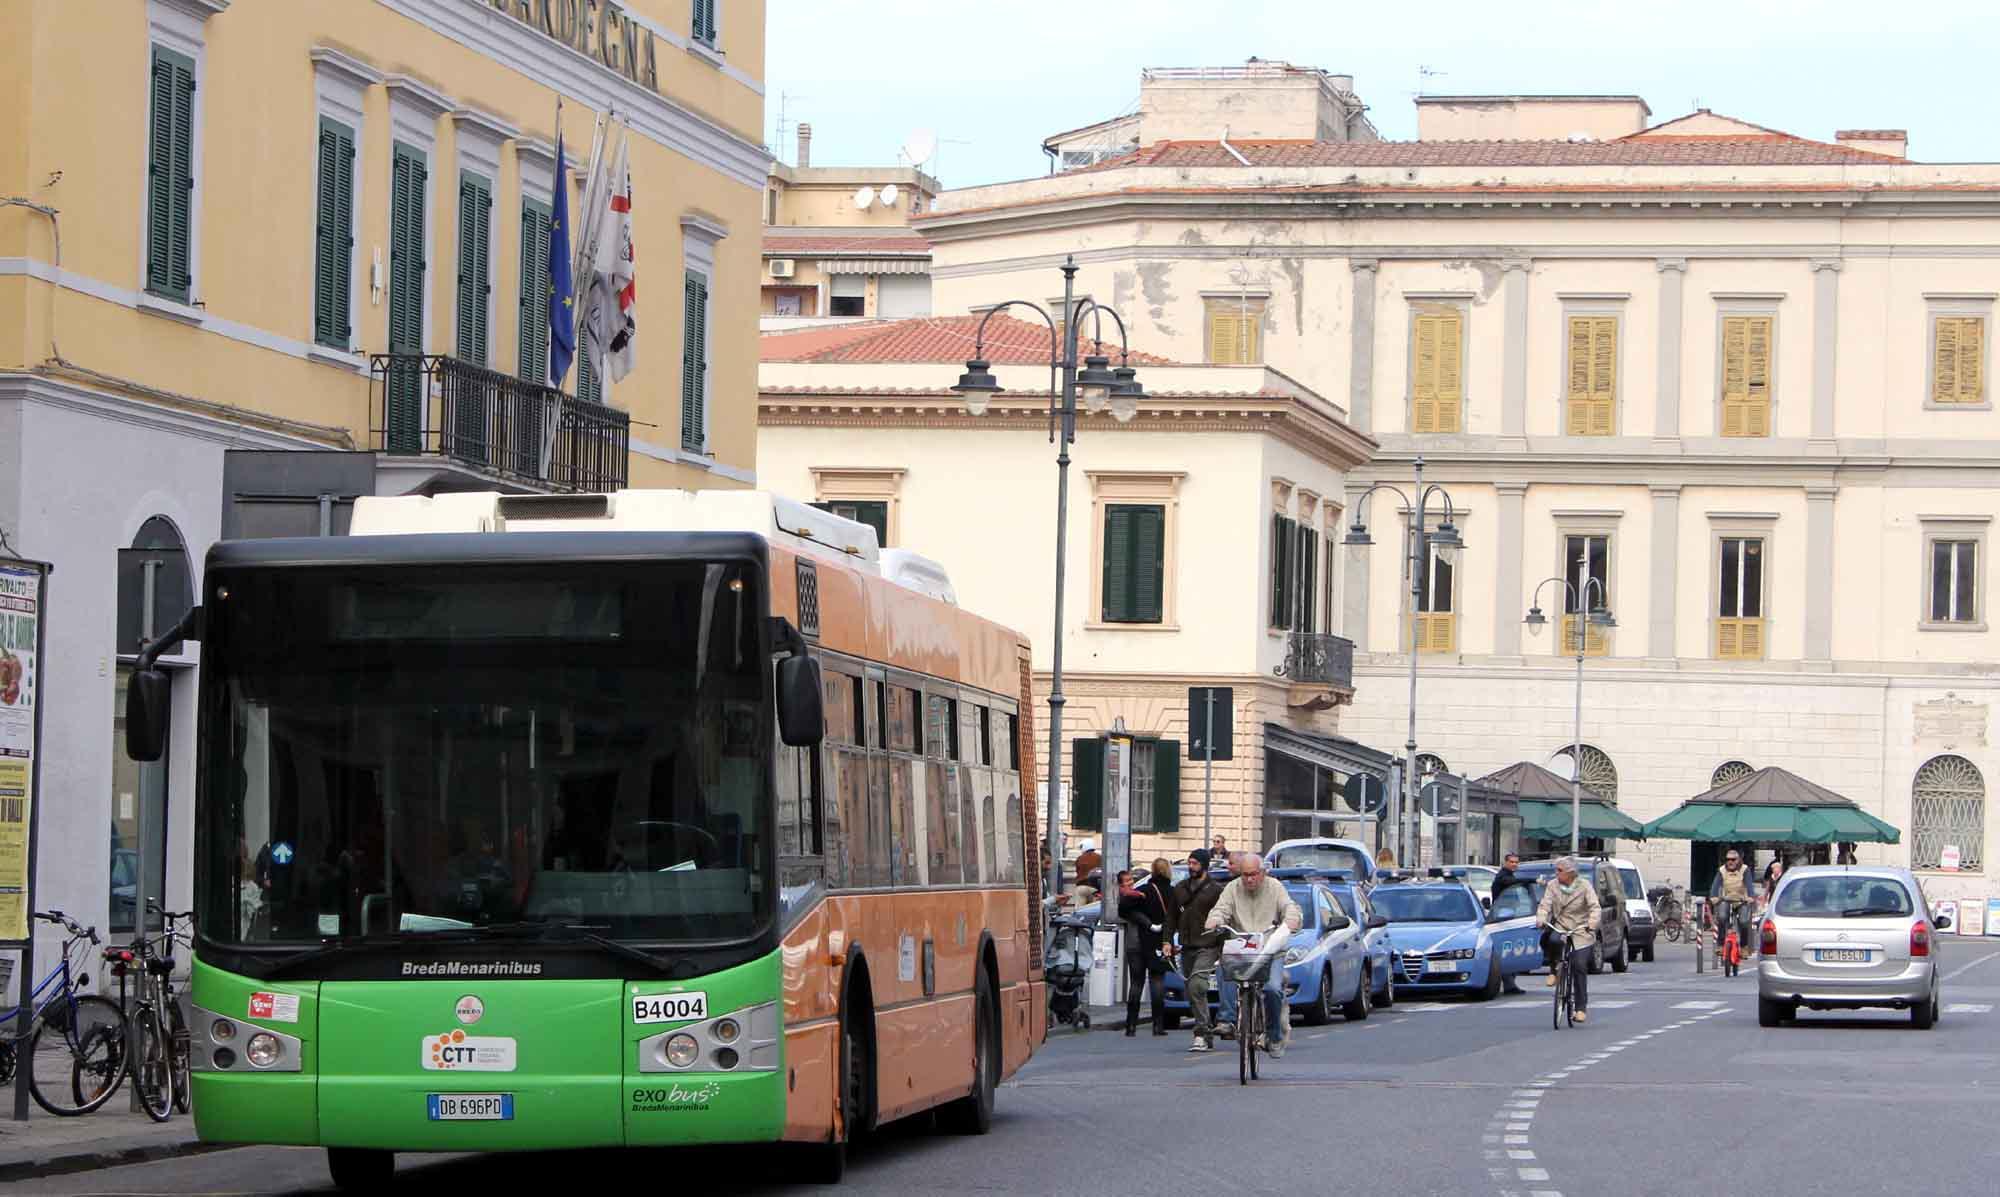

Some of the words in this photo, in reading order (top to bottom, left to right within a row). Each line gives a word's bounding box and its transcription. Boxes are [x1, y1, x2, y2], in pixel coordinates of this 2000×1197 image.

[402, 961, 541, 975] BredaMenarinibus
[635, 998, 703, 1019] B4004
[442, 1047, 476, 1063] CTT
[632, 1088, 667, 1103] exo
[440, 1099, 457, 1115] DB
[461, 1098, 501, 1115] 696PD
